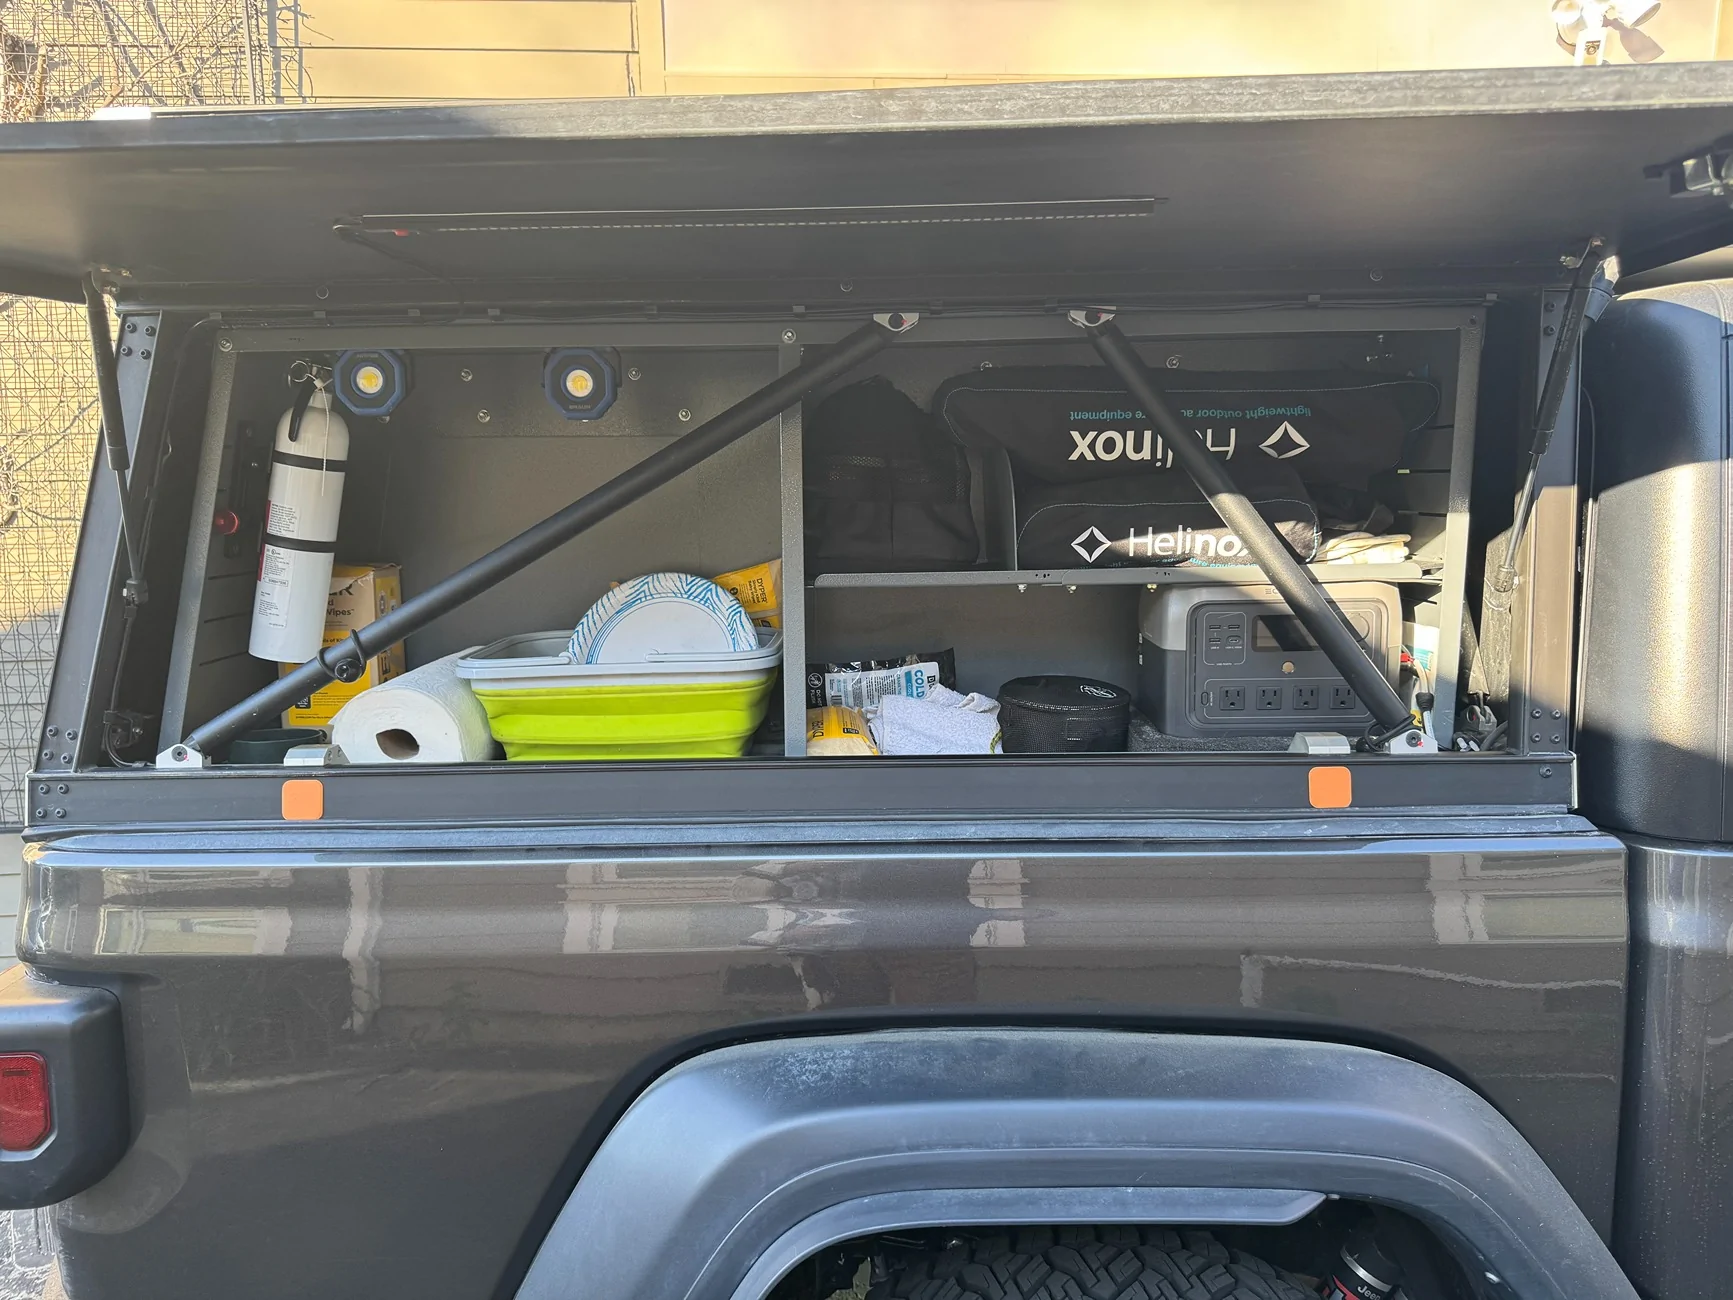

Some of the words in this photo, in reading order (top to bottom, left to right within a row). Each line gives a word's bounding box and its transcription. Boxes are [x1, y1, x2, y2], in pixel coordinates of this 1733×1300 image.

[1070, 410, 1132, 421] equipment
[1196, 408, 1242, 418] outdoor
[1246, 405, 1311, 419] lightweight
[1068, 428, 1236, 468] Hlinox
[757, 577, 767, 603] DYPER
[914, 669, 925, 698] COLD
